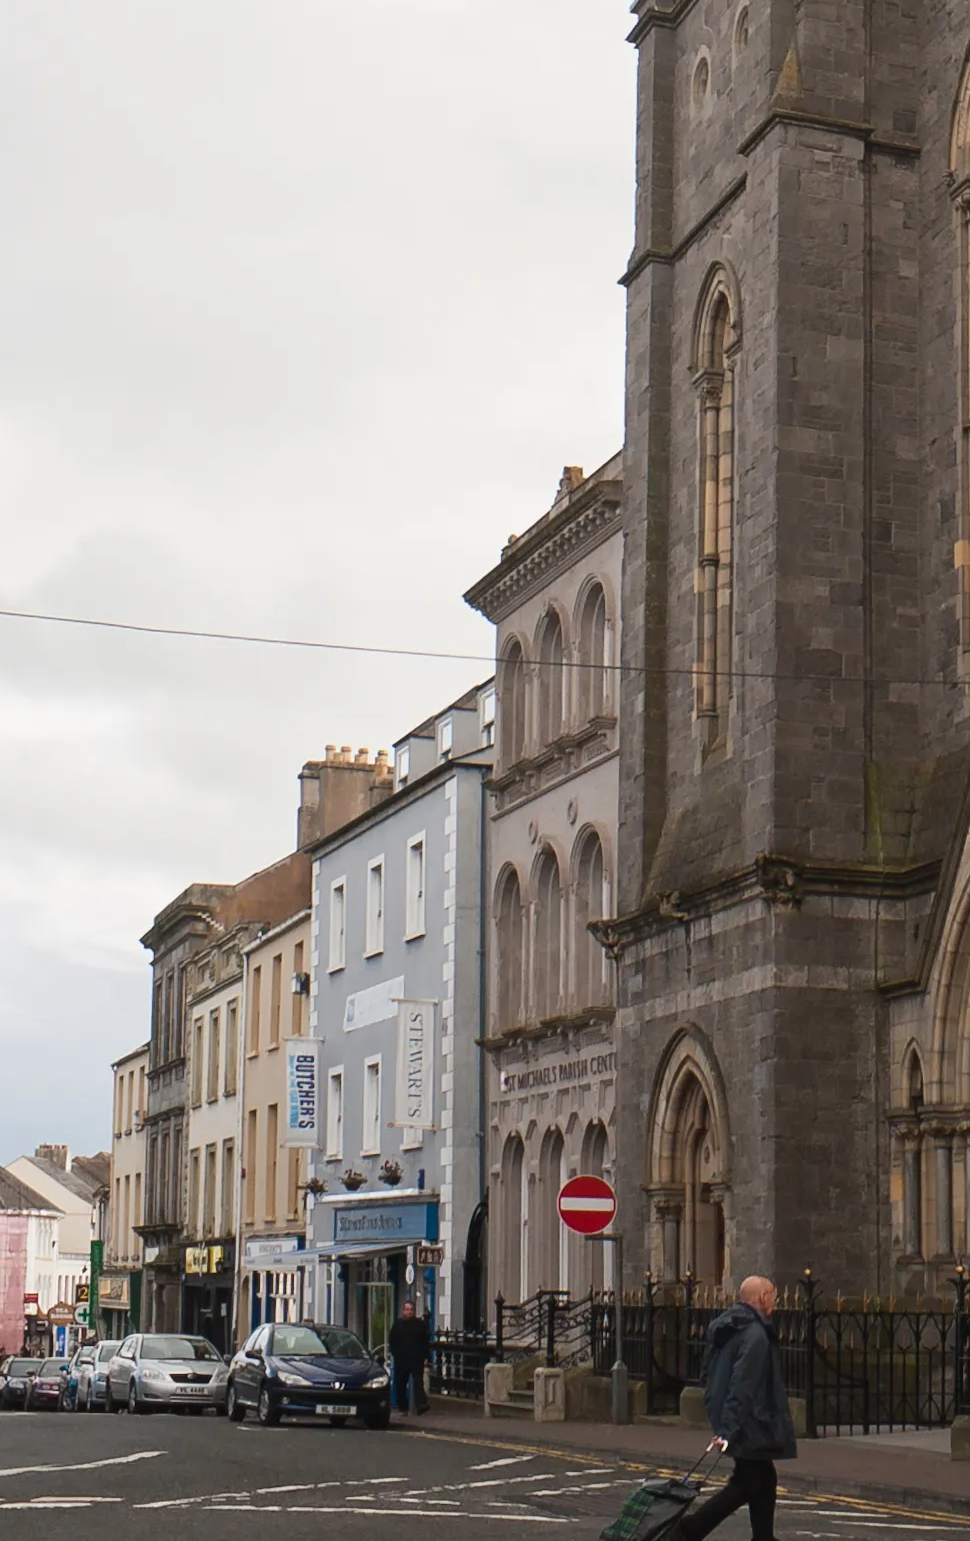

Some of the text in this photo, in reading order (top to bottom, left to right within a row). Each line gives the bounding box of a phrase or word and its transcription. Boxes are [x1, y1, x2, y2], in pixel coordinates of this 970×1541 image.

[295, 1055, 315, 1131] BUTCHER'S
[406, 1011, 424, 1119] STEWART'S
[559, 1059, 588, 1082] PARISH
